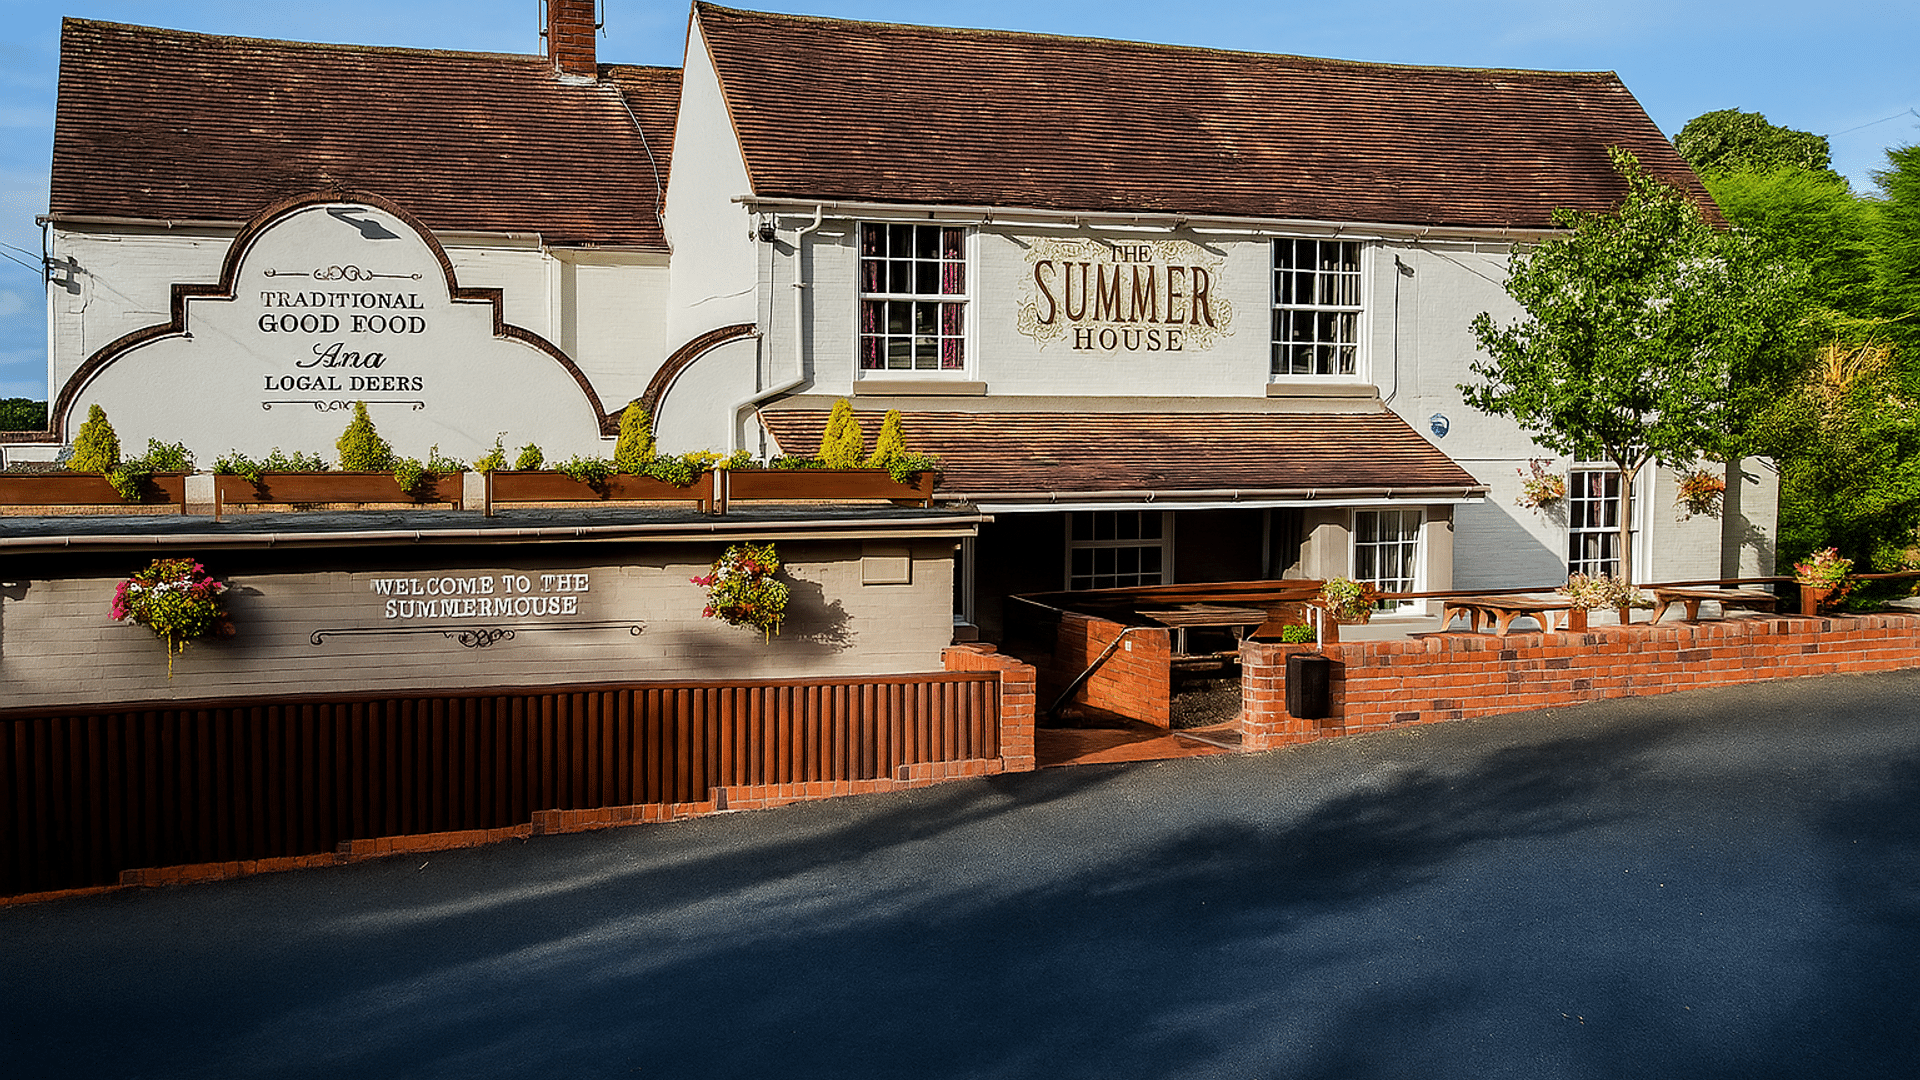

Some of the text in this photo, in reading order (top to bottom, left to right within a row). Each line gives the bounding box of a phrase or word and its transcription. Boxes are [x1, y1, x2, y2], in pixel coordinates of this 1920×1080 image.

[1111, 245, 1152, 263] THE
[260, 291, 424, 309] TRADITIONAL
[1034, 259, 1217, 328] SUMMER
[258, 313, 426, 334] GOOD FOOD
[1072, 328, 1183, 351] HOUSE
[372, 573, 589, 596] WELCOME TO THE
